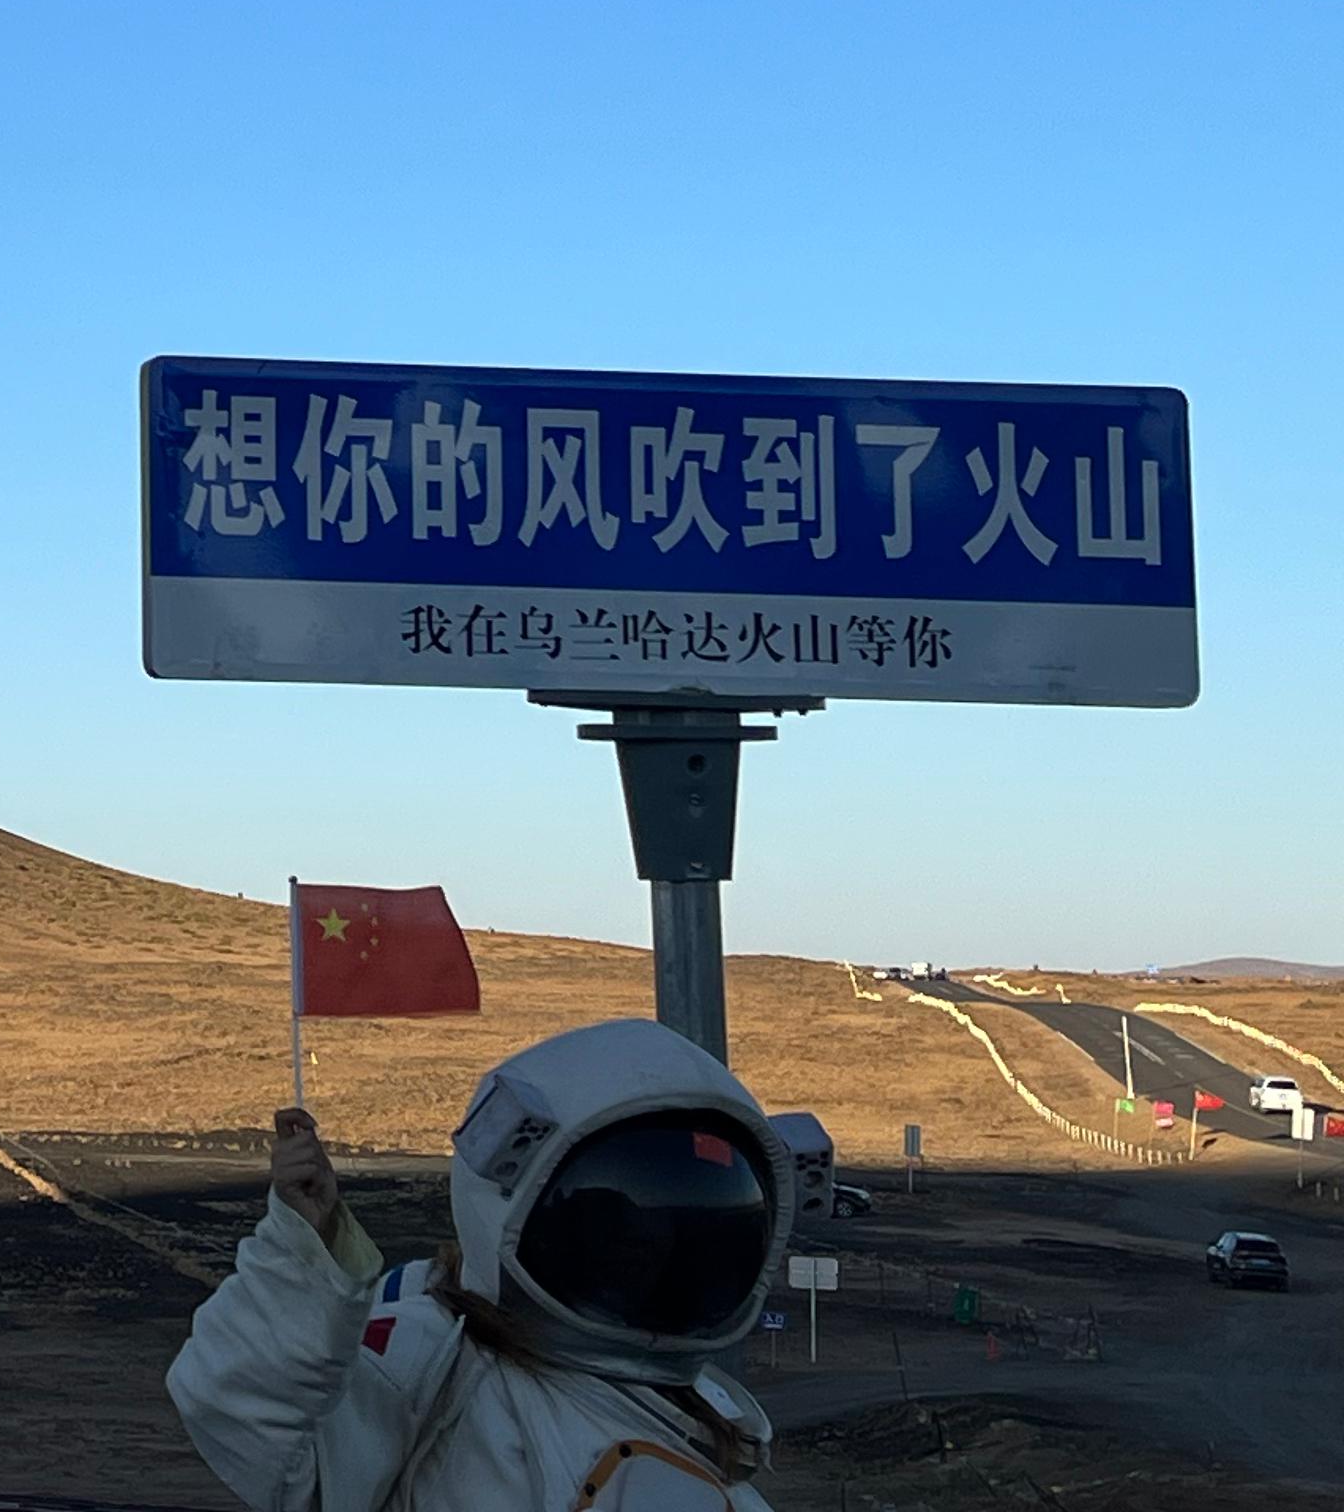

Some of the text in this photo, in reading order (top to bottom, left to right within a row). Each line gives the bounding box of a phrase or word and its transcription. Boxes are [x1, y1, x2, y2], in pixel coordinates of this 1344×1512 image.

[182, 390, 1162, 566] 想你的风吹到了火山
[401, 604, 952, 669] 我在乌兰哈达火山等你
